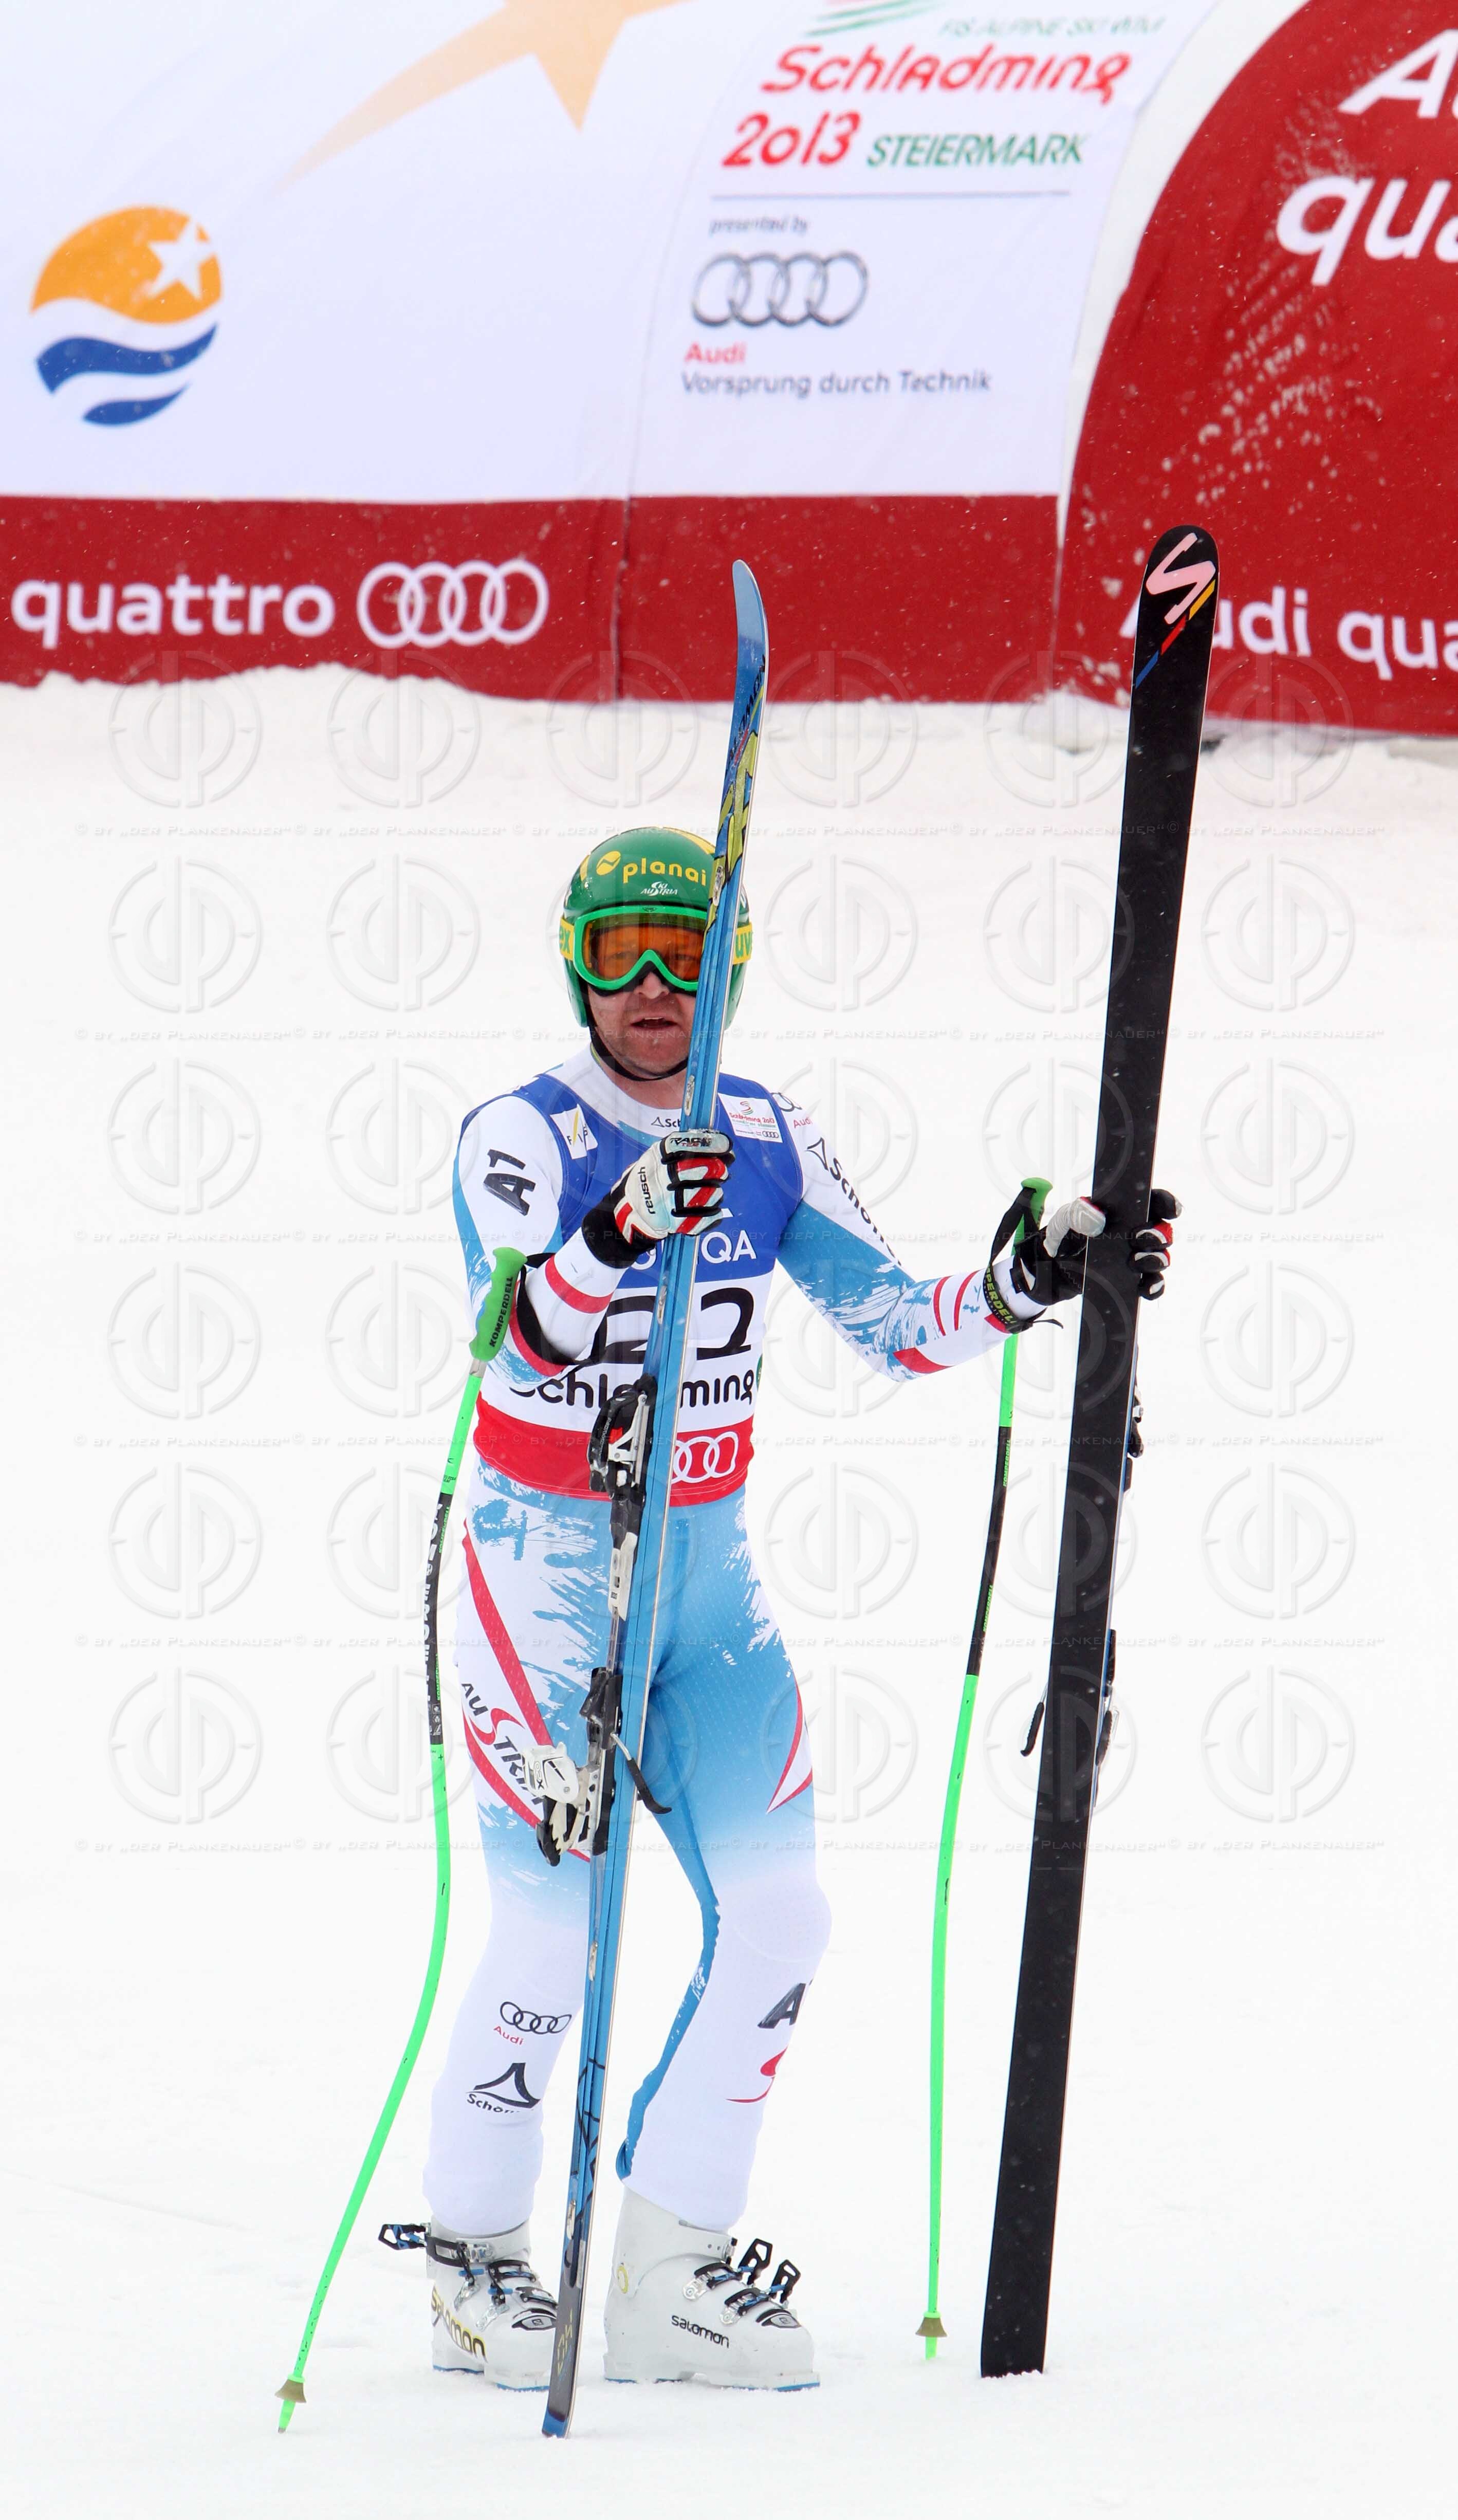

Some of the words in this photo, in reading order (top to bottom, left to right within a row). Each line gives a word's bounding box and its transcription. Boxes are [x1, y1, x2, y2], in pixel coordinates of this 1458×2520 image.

[761, 44, 1131, 106] Schladming
[1338, 29, 1458, 118] A
[722, 112, 861, 168] 2013
[867, 134, 1086, 168] STEIERMARK
[684, 343, 746, 365] Audi
[681, 371, 812, 399] Vorsprung
[820, 372, 890, 395] durch
[899, 370, 992, 393] Technik
[11, 574, 336, 649] quattro
[1119, 585, 1311, 657] udi
[623, 858, 706, 886] planai
[483, 1149, 536, 1217] A1
[637, 1166, 656, 1215] reusch
[489, 1276, 513, 1348] KOMPERDELL
[509, 1368, 754, 1409] chlming
[758, 1979, 813, 2029] A
[493, 2026, 524, 2046] Audi
[671, 2315, 730, 2348] salomon
